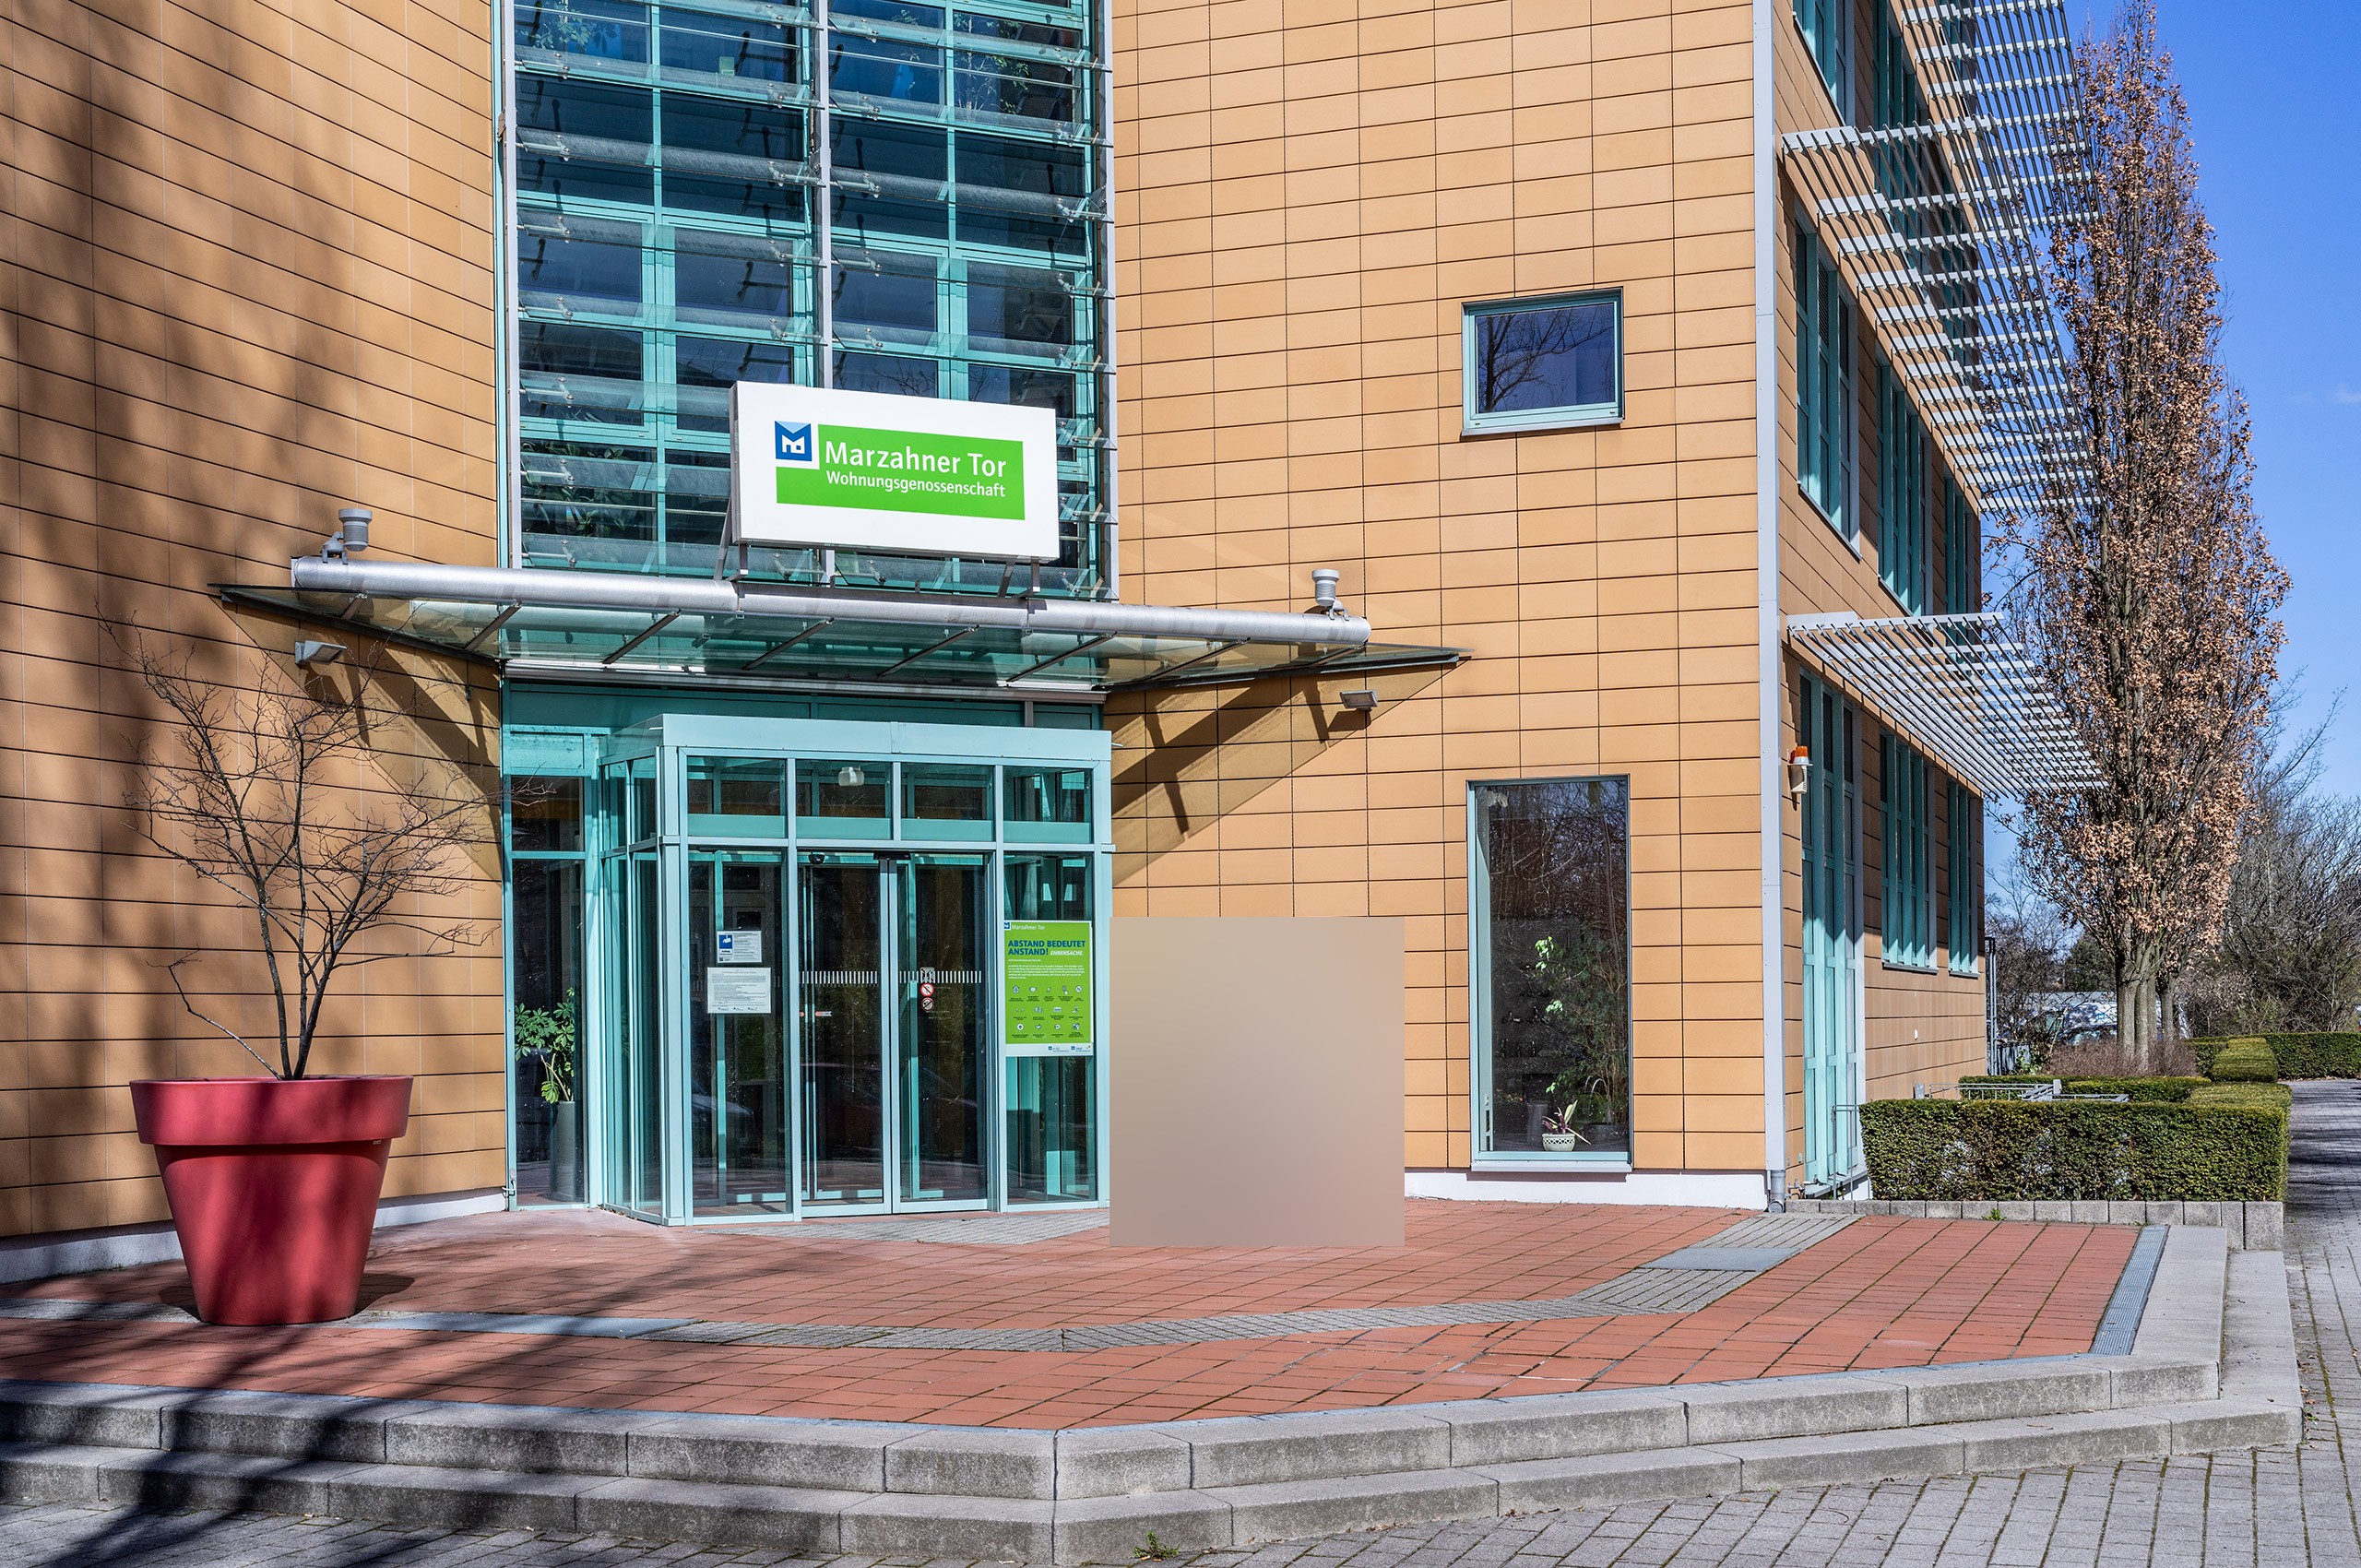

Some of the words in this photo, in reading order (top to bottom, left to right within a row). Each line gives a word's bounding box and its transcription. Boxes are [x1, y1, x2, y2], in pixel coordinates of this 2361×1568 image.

[825, 441, 961, 474] Marzahner
[967, 453, 1006, 478] Tor
[826, 470, 1005, 498] Wohnungsgenossenschaft
